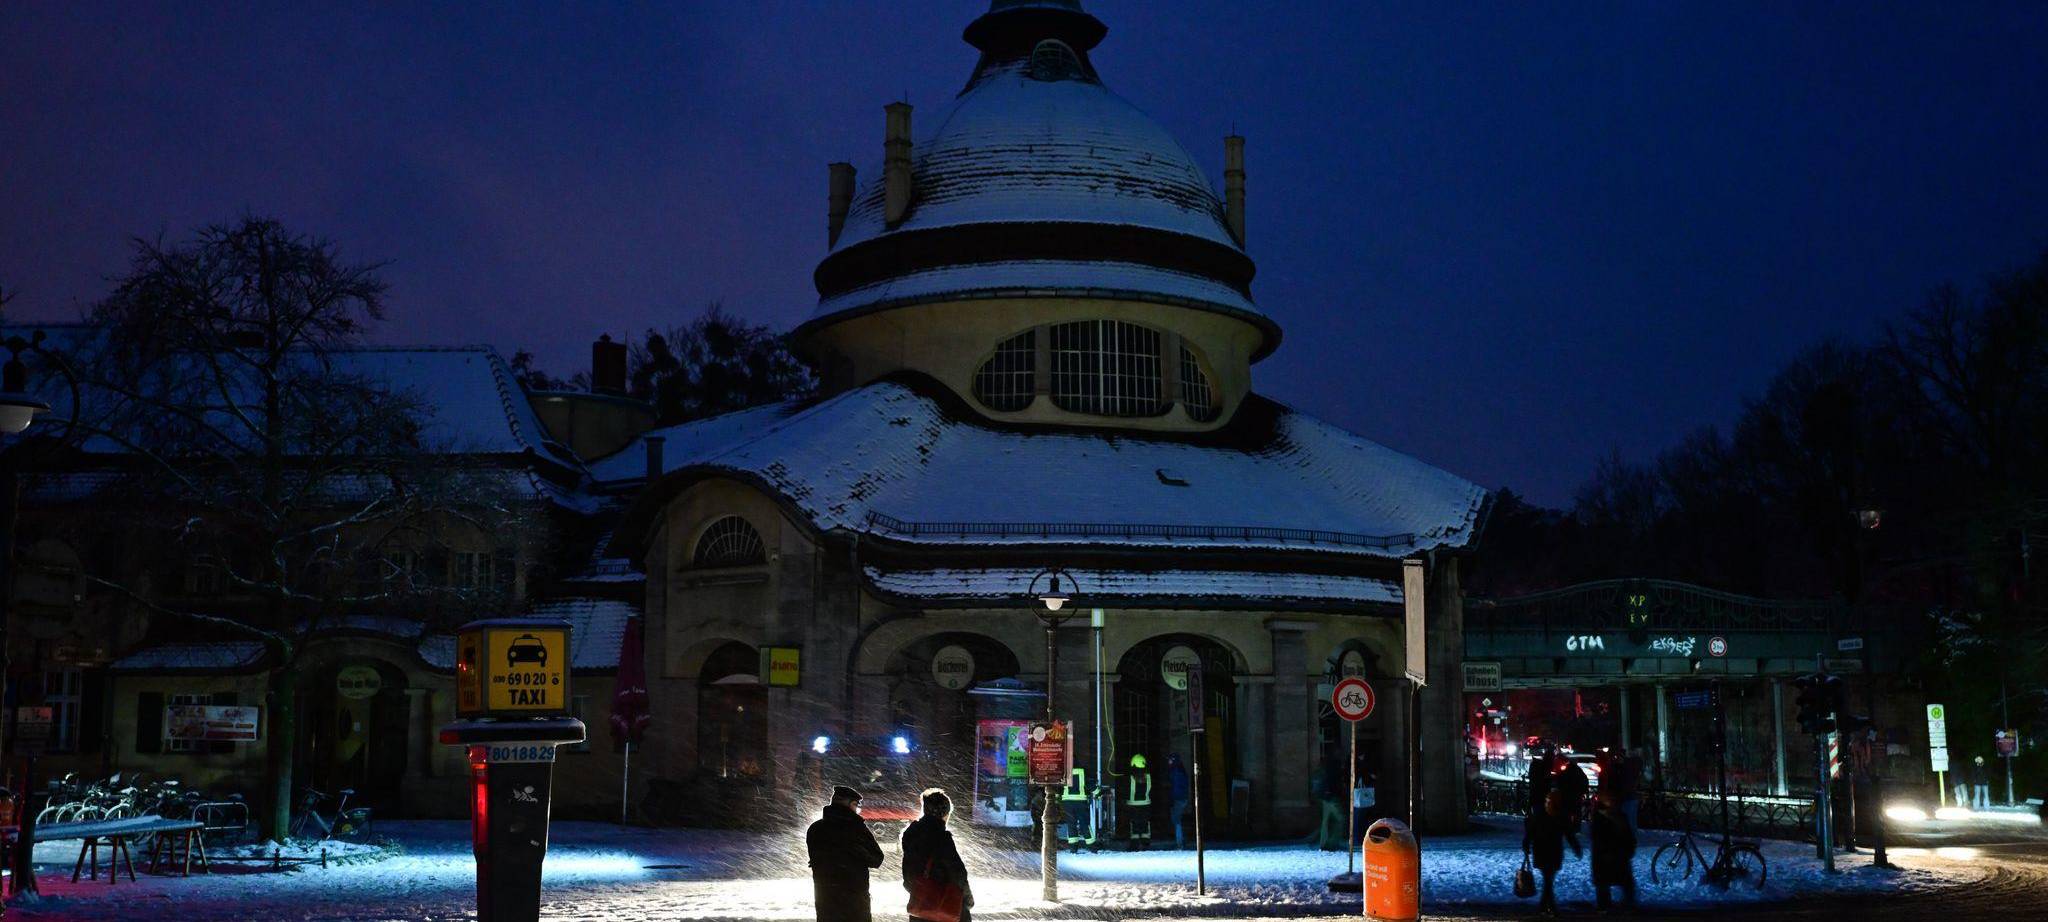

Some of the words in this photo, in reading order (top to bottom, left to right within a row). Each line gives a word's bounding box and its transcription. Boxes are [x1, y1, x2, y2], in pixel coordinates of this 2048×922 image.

[1567, 635, 1604, 651] GTM
[508, 689, 546, 705] TAXI
[493, 746, 554, 761] 8018829
